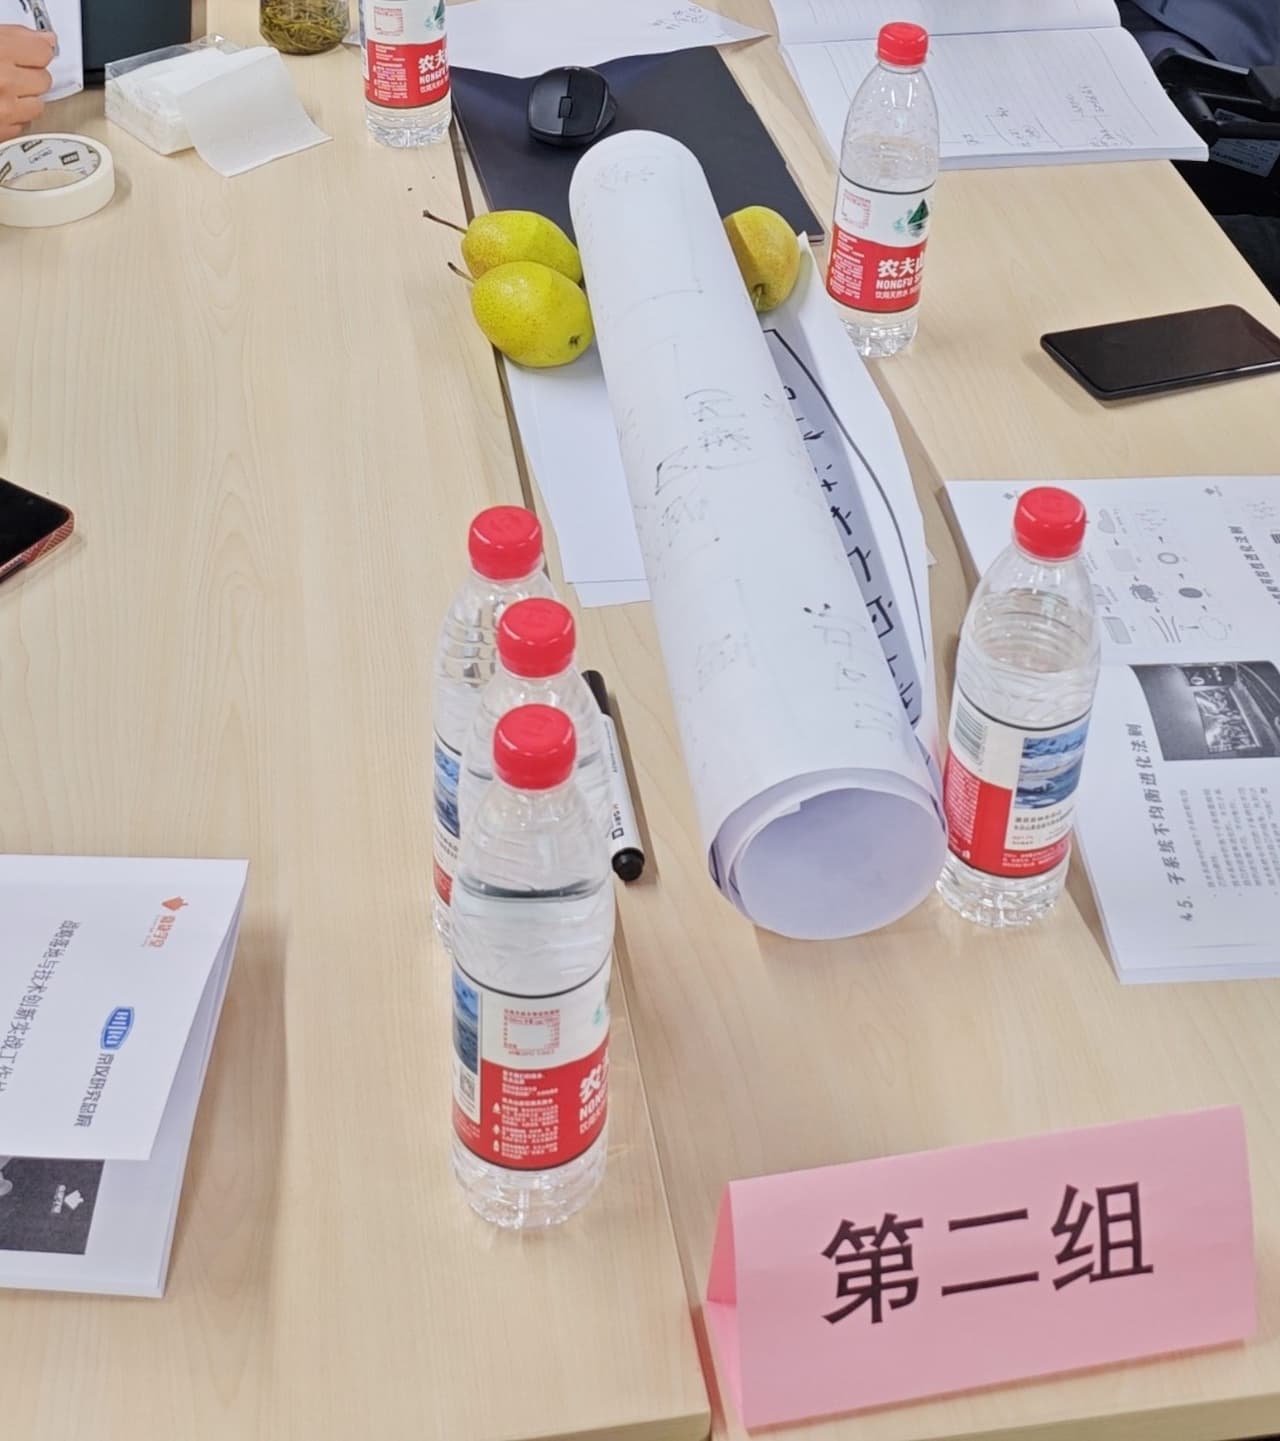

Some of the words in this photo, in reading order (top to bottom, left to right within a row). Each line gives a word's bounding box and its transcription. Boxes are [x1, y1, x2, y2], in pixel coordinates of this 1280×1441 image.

[876, 276, 913, 289] NONGFU
[1125, 722, 1184, 885] 子系统不均衡进化法则
[74, 1052, 114, 1128] 京仪研究总院
[821, 1181, 1154, 1324] 第二组
